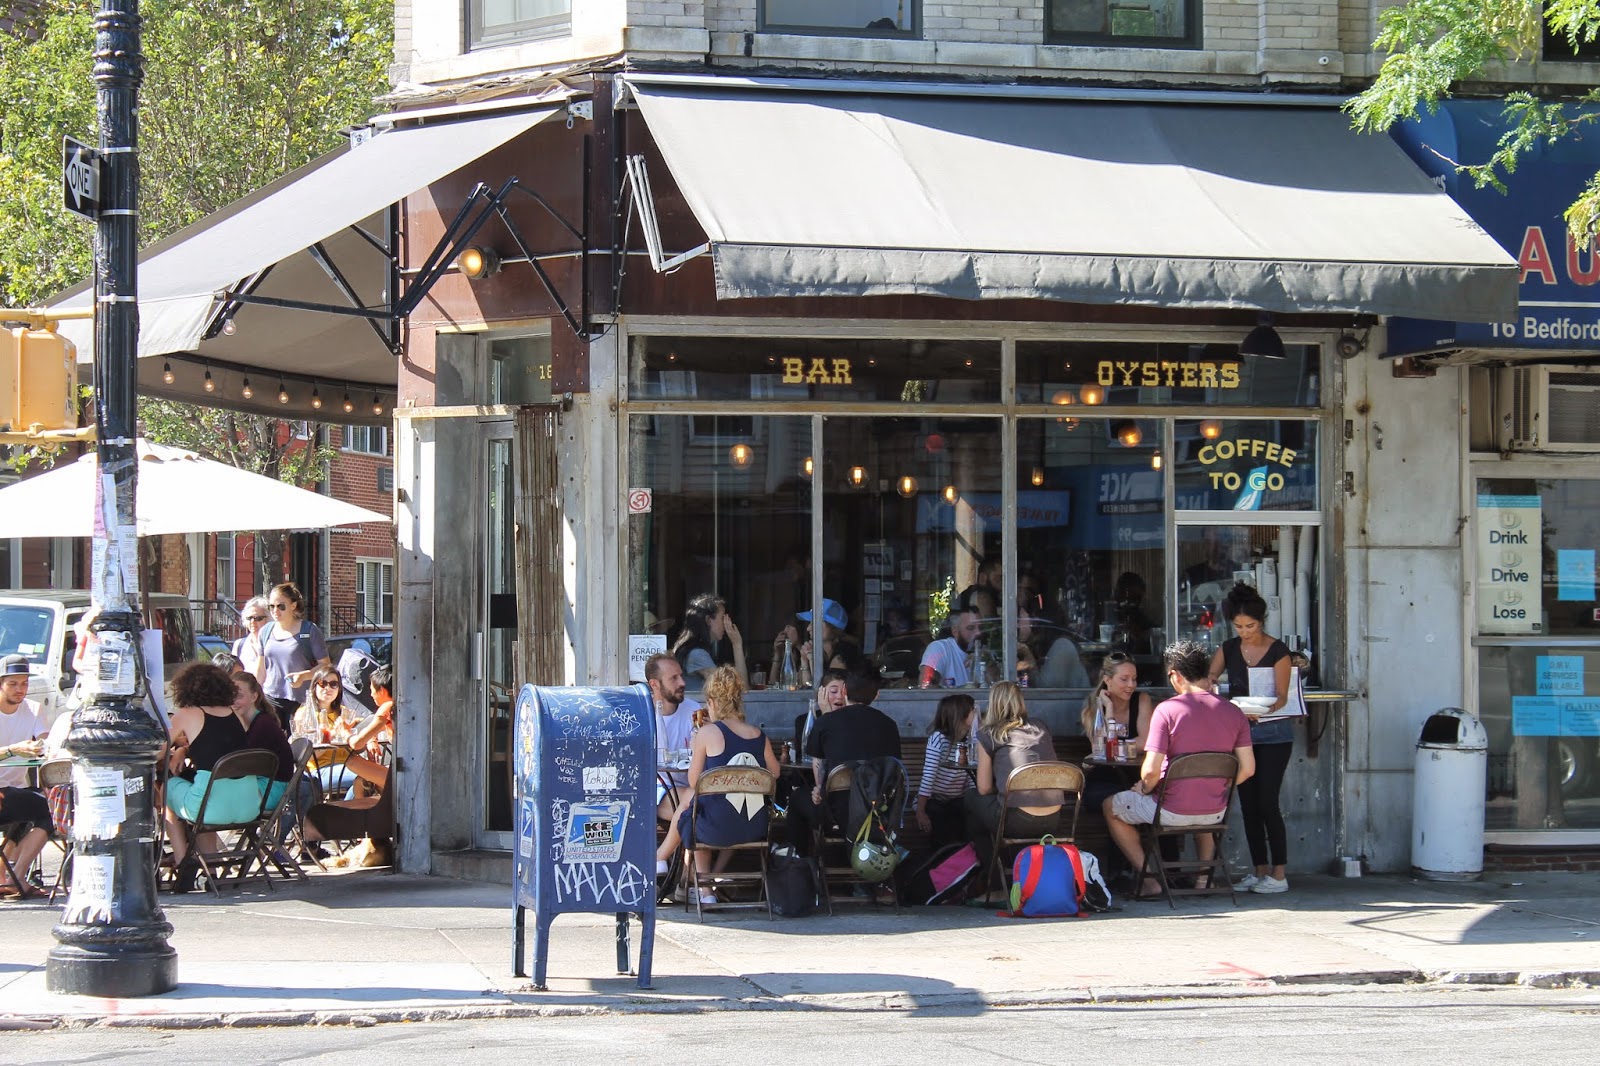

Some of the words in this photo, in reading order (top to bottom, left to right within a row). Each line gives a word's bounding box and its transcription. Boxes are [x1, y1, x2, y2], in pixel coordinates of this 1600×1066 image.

[71, 163, 90, 195] ONE
[1523, 317, 1600, 340] Bedford
[782, 357, 852, 384] BAR
[1097, 360, 1241, 388] OYSTERS
[1198, 438, 1298, 468] COFFEE
[1209, 472, 1241, 491] TO
[1249, 472, 1285, 492] GO
[1489, 530, 1528, 544] Drink
[1491, 568, 1529, 582] Drive
[1493, 605, 1526, 619] Lose
[1542, 671, 1578, 680] SERVICES
[1540, 682, 1580, 691] AVAILABLE
[592, 845, 616, 853] STATES
